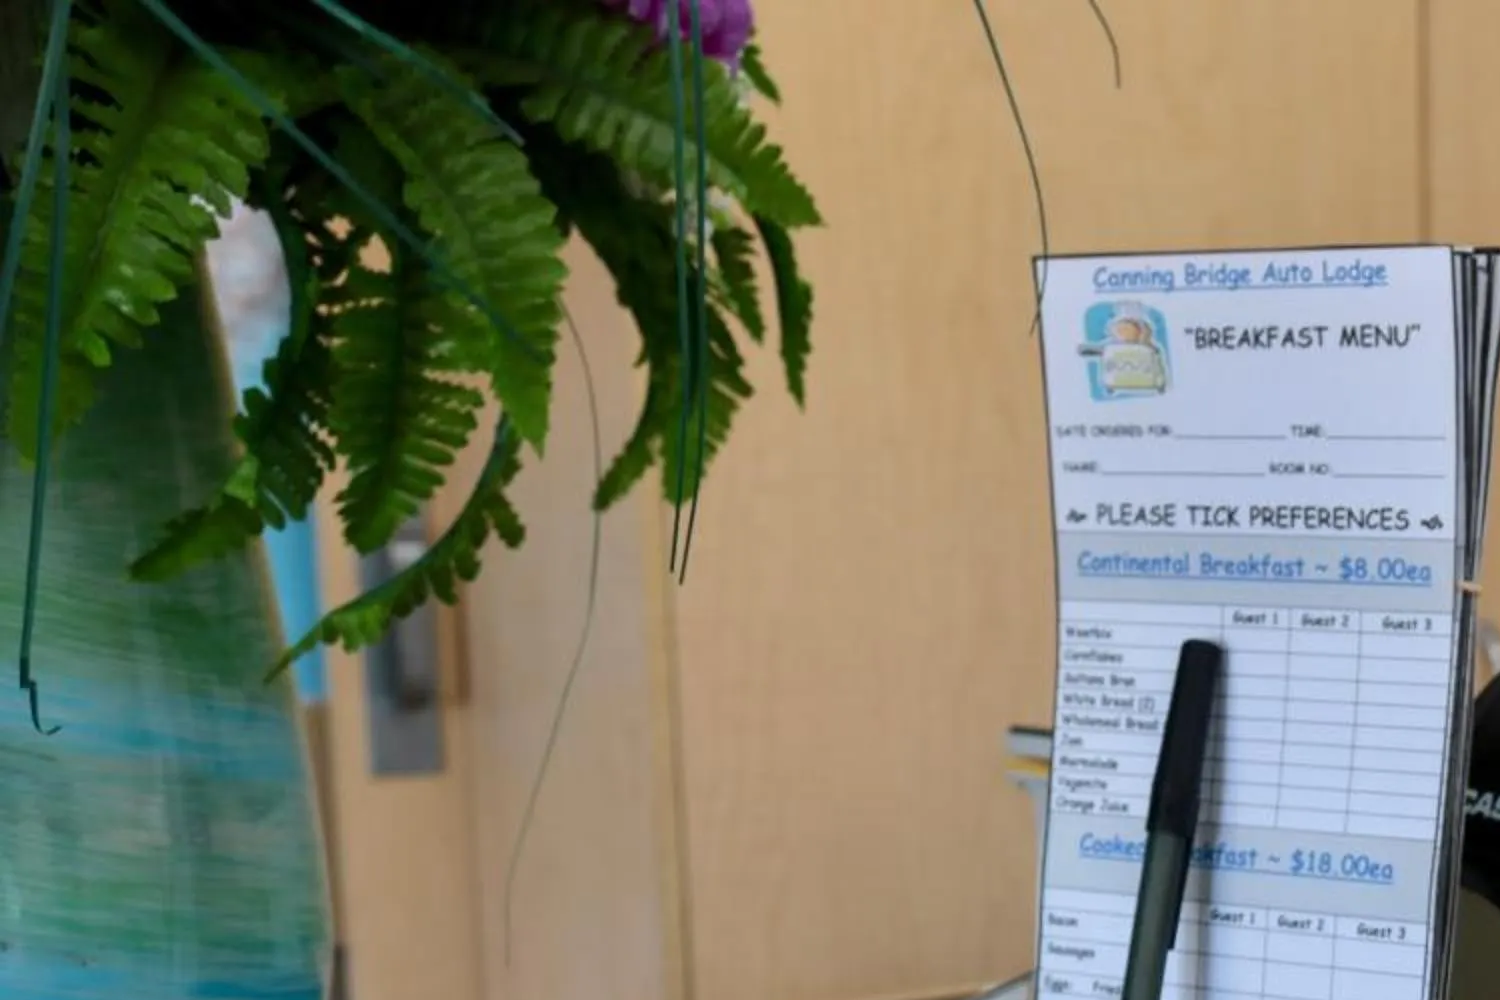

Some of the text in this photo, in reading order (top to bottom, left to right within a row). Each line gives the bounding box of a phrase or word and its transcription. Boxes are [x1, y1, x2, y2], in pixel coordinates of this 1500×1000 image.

[1093, 259, 1389, 291] Canning Bridge Auto Lodge
[1096, 503, 1411, 532] PLEASE TICK PREFERENCES
[1077, 550, 1191, 575] Continental
[1200, 552, 1304, 577] Breakfast
[1339, 556, 1433, 583] $8.00ea
[1290, 845, 1395, 880] $18.00ea
